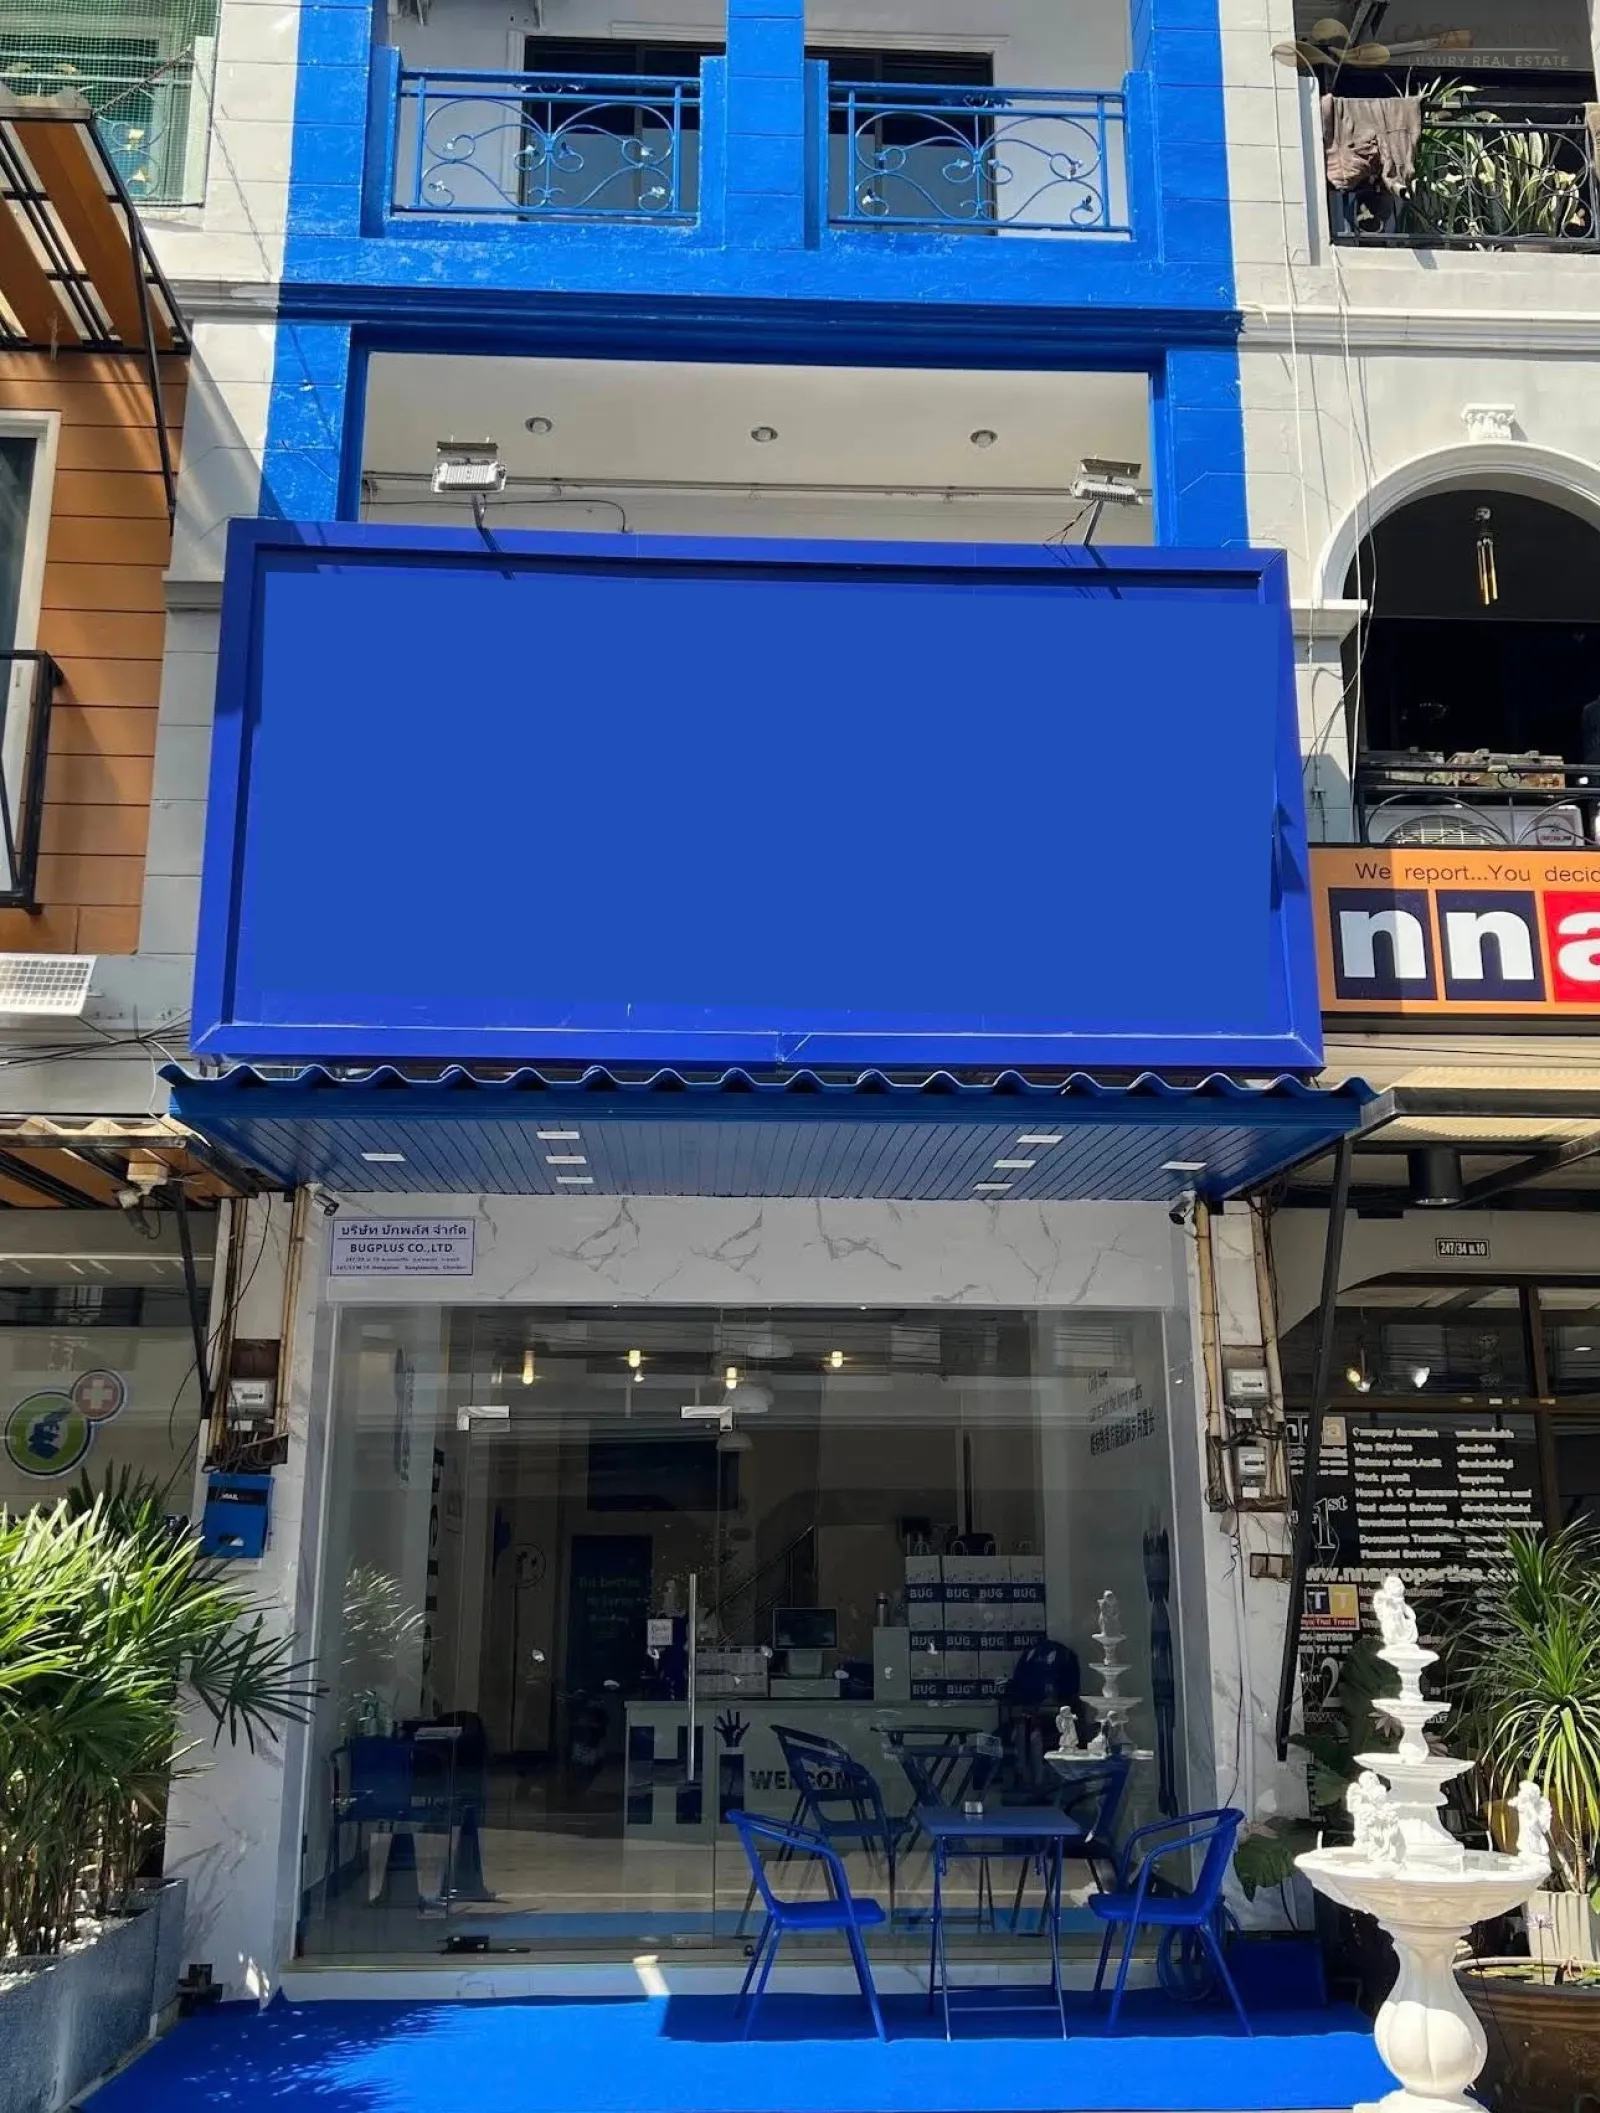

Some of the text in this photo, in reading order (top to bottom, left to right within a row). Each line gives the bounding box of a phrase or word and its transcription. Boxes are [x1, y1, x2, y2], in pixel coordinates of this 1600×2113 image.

[1355, 862, 1391, 880] We
[433, 1223, 467, 1236] จำกัด
[350, 1243, 404, 1253] BUGPLUS
[909, 1588, 1037, 1599] BUG BUG BUG BUG
[946, 1636, 970, 1646] BUG
[981, 1636, 1004, 1647] BUG
[912, 1684, 1005, 1695] BUG BUG BUG
